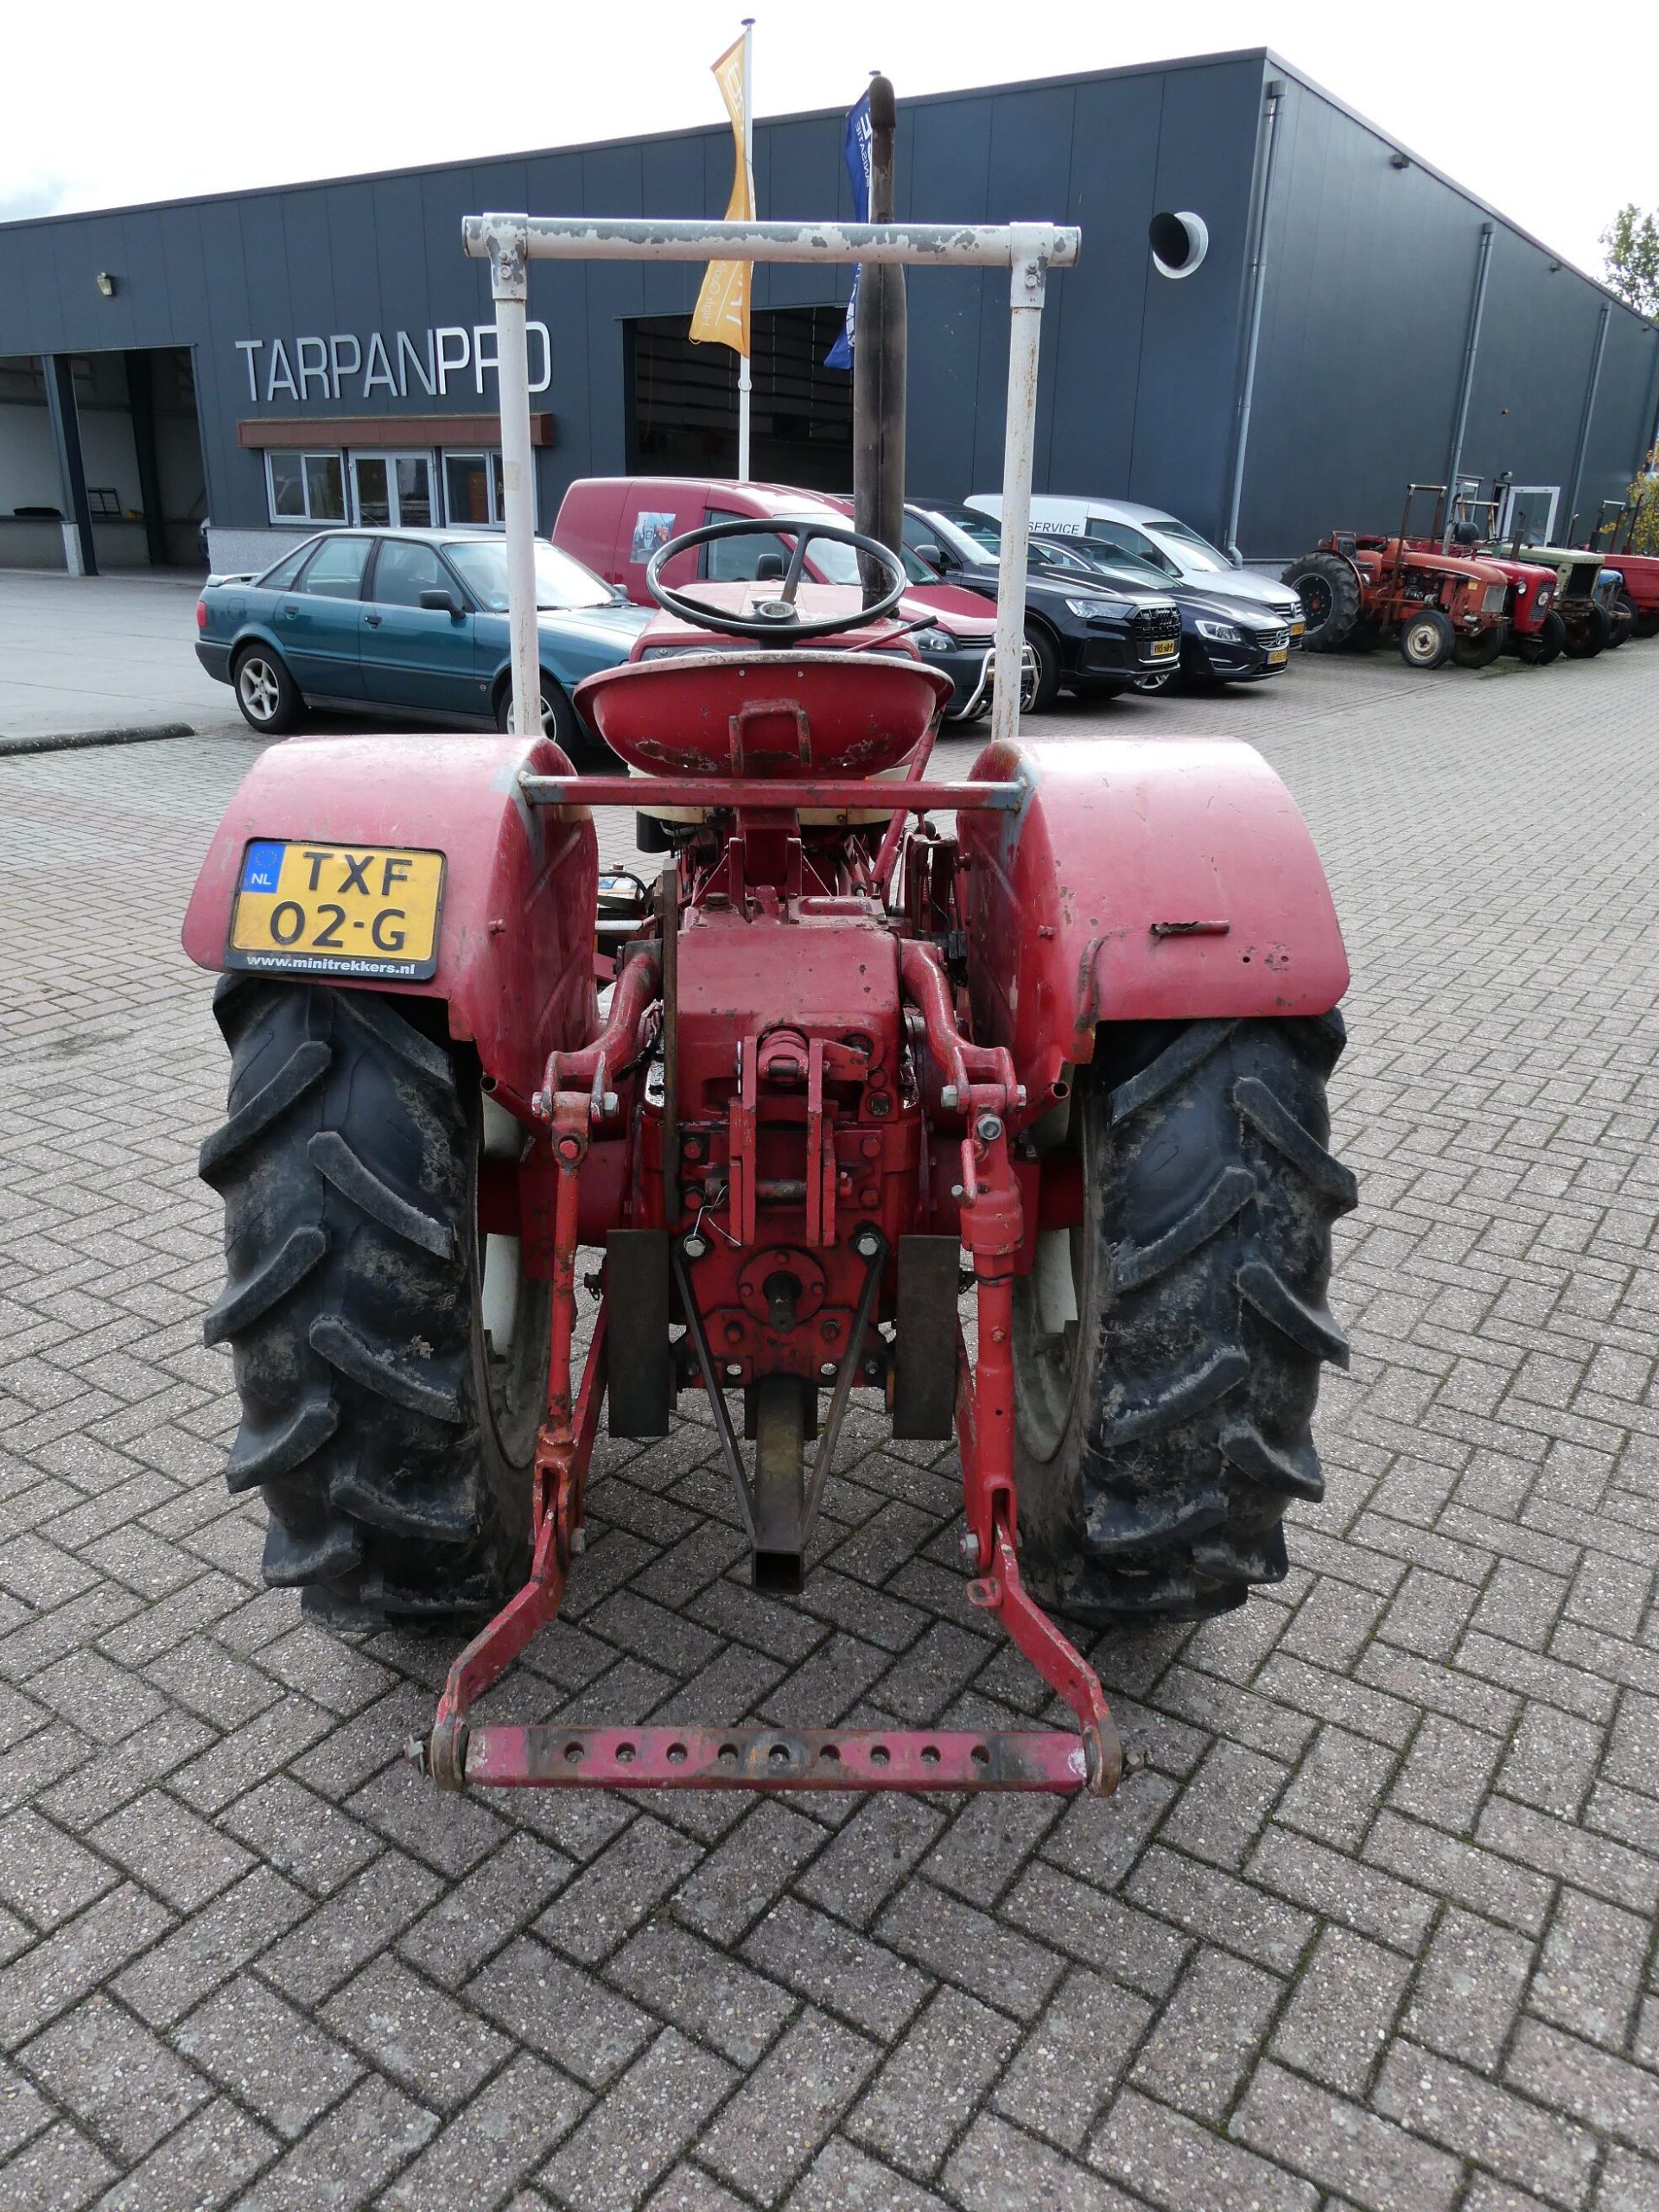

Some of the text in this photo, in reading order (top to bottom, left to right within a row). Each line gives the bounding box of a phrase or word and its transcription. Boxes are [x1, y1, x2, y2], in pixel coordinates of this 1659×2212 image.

[1028, 521, 1080, 535] SERVICE
[251, 873, 271, 886] NL
[302, 851, 413, 896] TXF
[269, 900, 406, 952] 02-G
[246, 955, 416, 976] www.minitrekkers.nl
